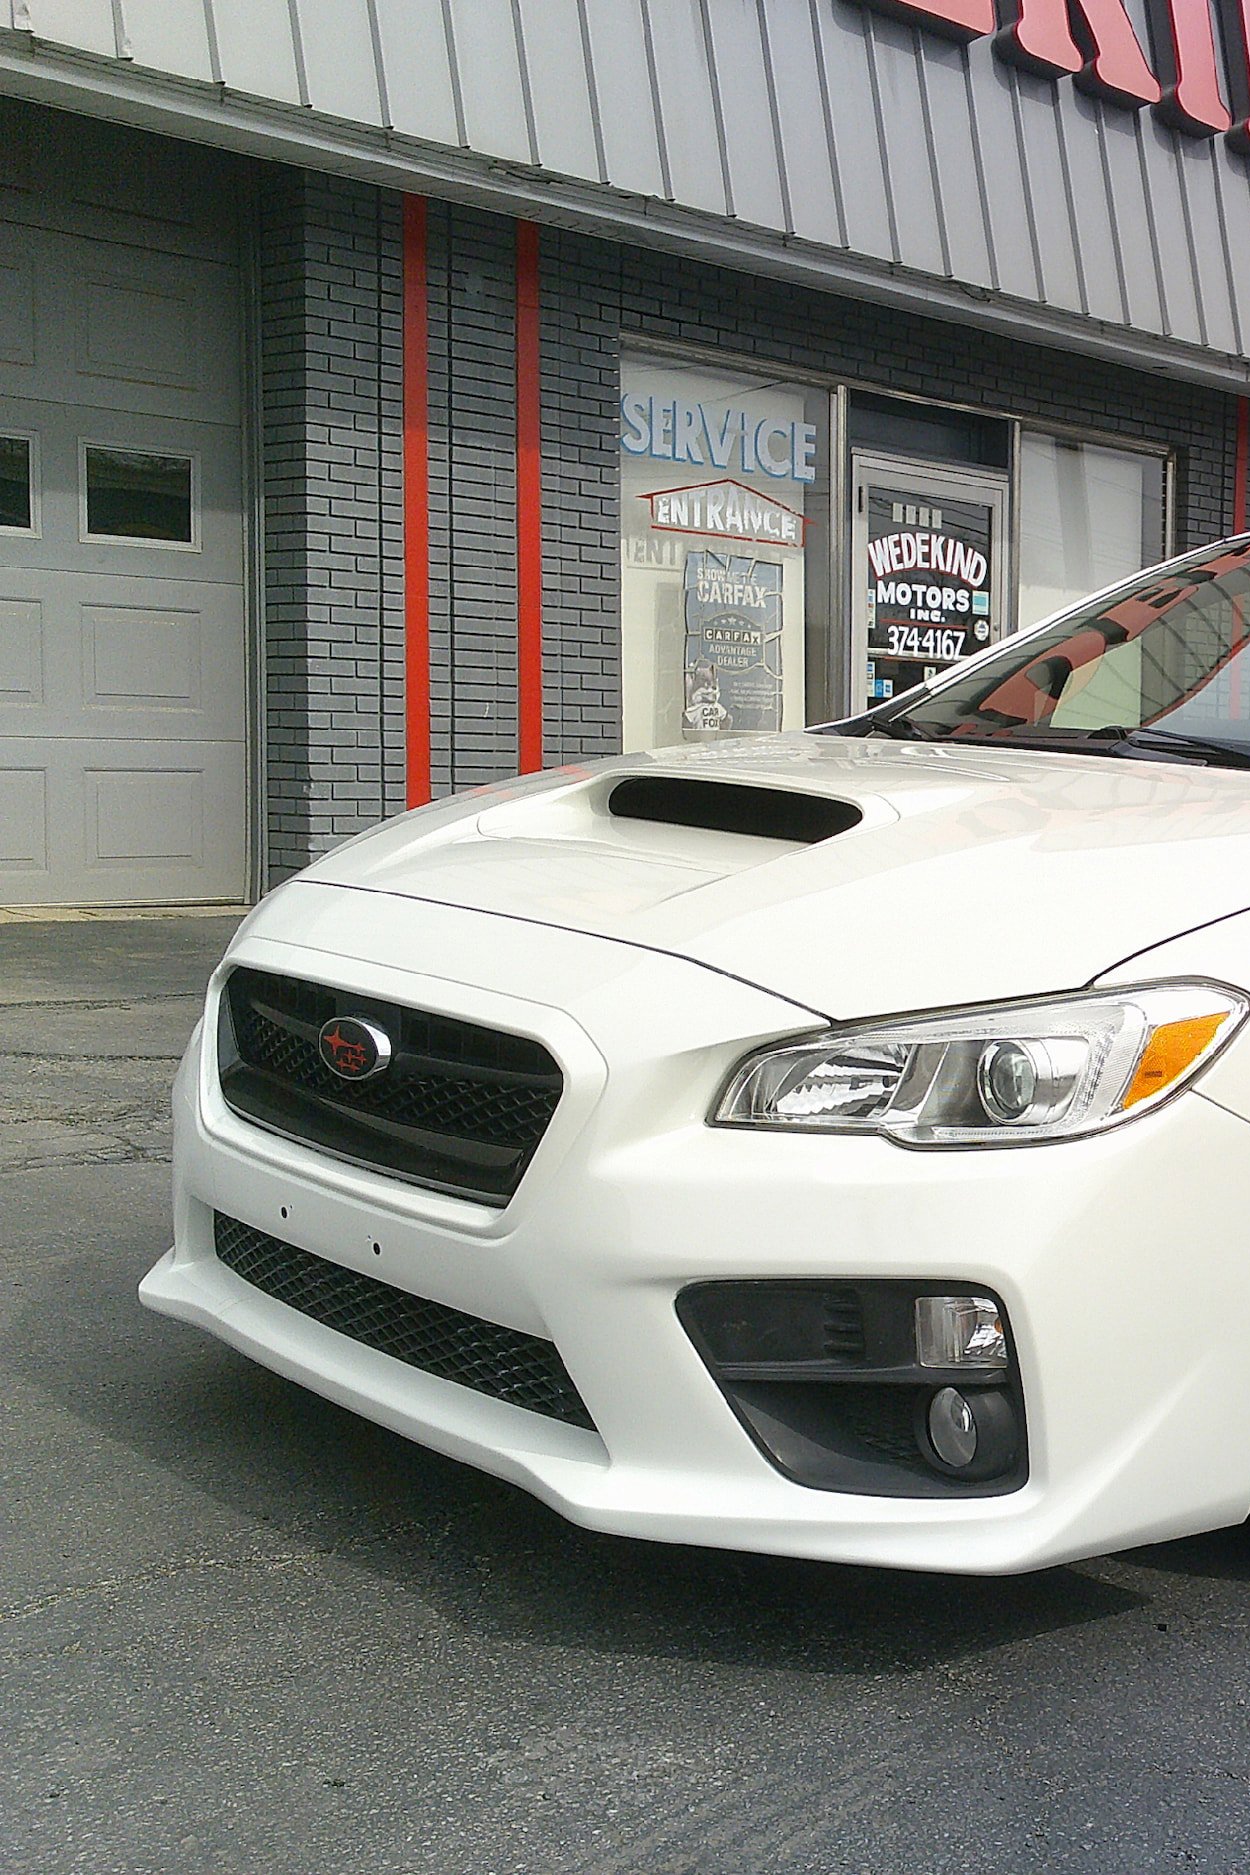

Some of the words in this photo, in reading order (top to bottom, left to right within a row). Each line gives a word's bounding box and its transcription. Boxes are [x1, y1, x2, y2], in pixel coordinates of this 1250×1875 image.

[620, 393, 817, 484] SERVICE
[656, 486, 797, 541] ENTRANCE
[867, 532, 988, 589] WEDEKIND
[697, 580, 768, 609] CARFAX
[876, 580, 971, 613] MOTORS
[909, 608, 947, 624] INC.
[705, 629, 761, 645] CARFAX
[709, 643, 757, 657] ADVANTAGE
[887, 625, 966, 662] 374-4167
[717, 655, 749, 668] DEALER
